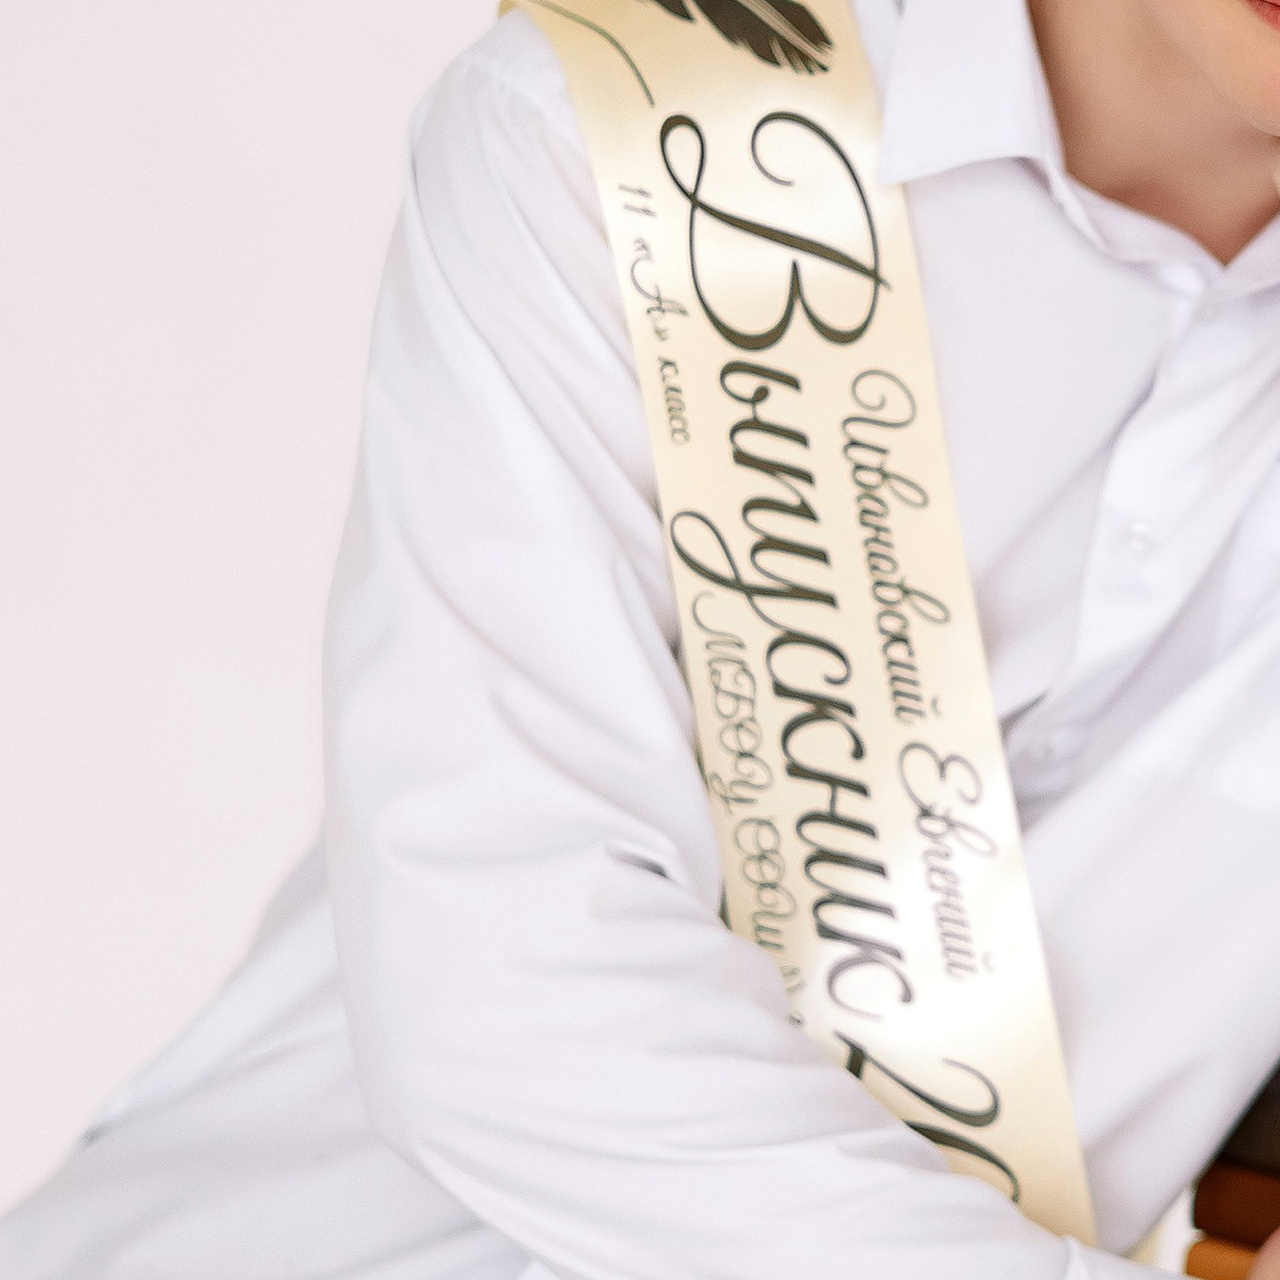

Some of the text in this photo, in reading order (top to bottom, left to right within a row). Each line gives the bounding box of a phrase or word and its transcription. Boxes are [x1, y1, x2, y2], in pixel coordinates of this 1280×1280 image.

[617, 180, 658, 219] 11
[658, 355, 691, 446] класс
[660, 110, 913, 1020] Выпускник
[691, 590, 774, 814] МБОУ
[841, 368, 998, 980] Ивановский Евгений
